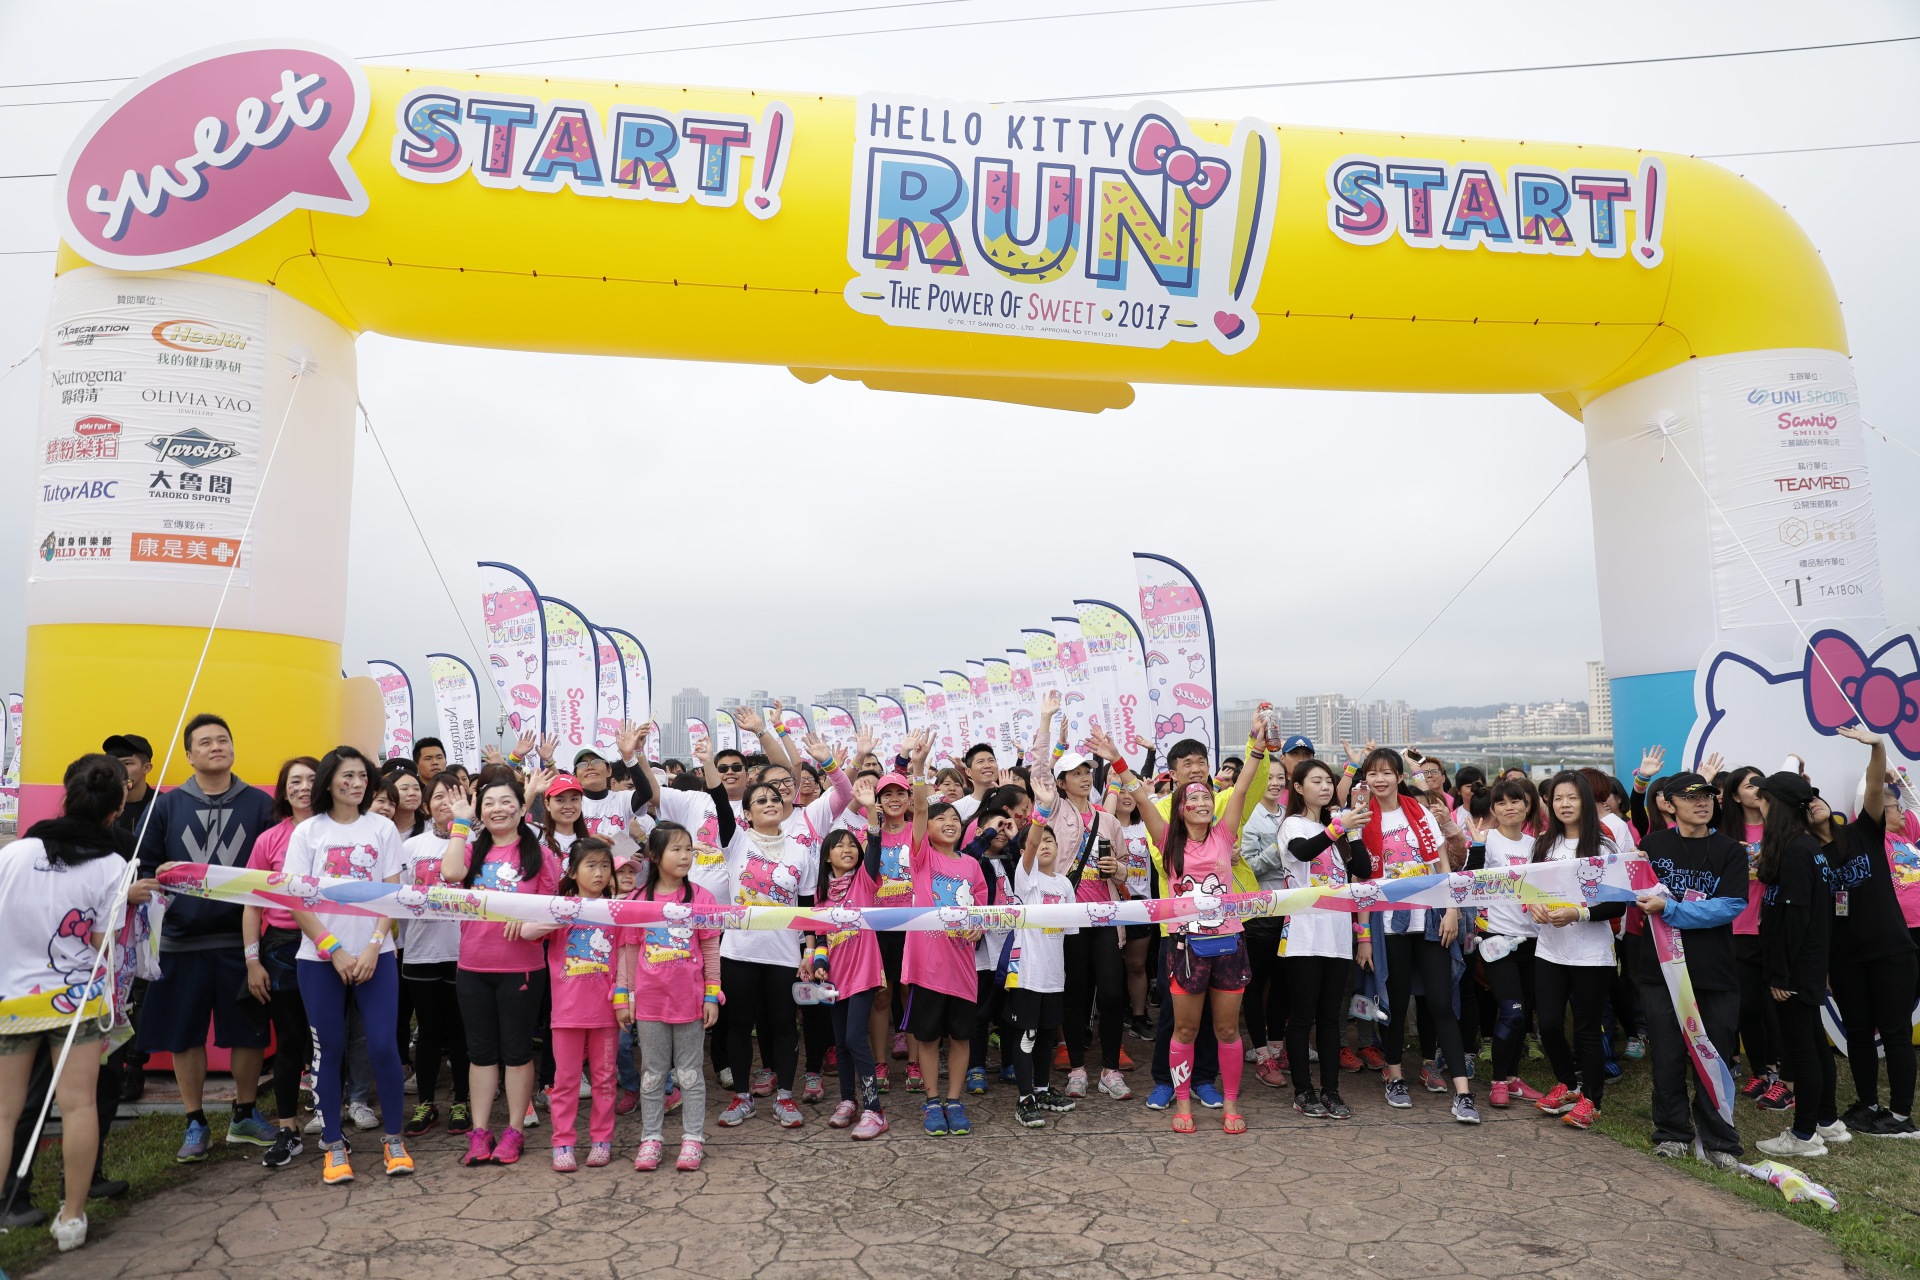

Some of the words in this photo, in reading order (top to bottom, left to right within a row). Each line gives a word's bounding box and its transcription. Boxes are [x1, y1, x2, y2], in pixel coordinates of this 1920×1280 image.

[870, 102, 982, 146] HELLO
[1007, 114, 1124, 157] KITTY
[86, 69, 328, 241] sweet
[400, 92, 784, 210] START!
[1334, 161, 1657, 259] START!
[889, 280, 921, 310] THE
[927, 283, 993, 318] POWER
[1000, 289, 1024, 319] OF
[1028, 292, 1097, 326] SWEET
[1118, 301, 1171, 331] 2017
[157, 352, 242, 373] 我的健康專研
[142, 389, 208, 407] OLIVIA
[214, 395, 252, 413] YAO
[1771, 390, 1801, 405] UNI
[1777, 412, 1837, 430] Sanrio
[151, 434, 235, 463] Taroko
[43, 481, 118, 502] TutorABC
[149, 470, 232, 494] 大魯閣
[1774, 476, 1850, 492] TEAMRED
[149, 491, 189, 500] TAROKO
[192, 494, 231, 503] SPORTS
[79, 547, 112, 557] GYM
[137, 538, 208, 560] 康是美
[1819, 584, 1864, 597] TAIBON
[1113, 707, 1122, 744] SMILES
